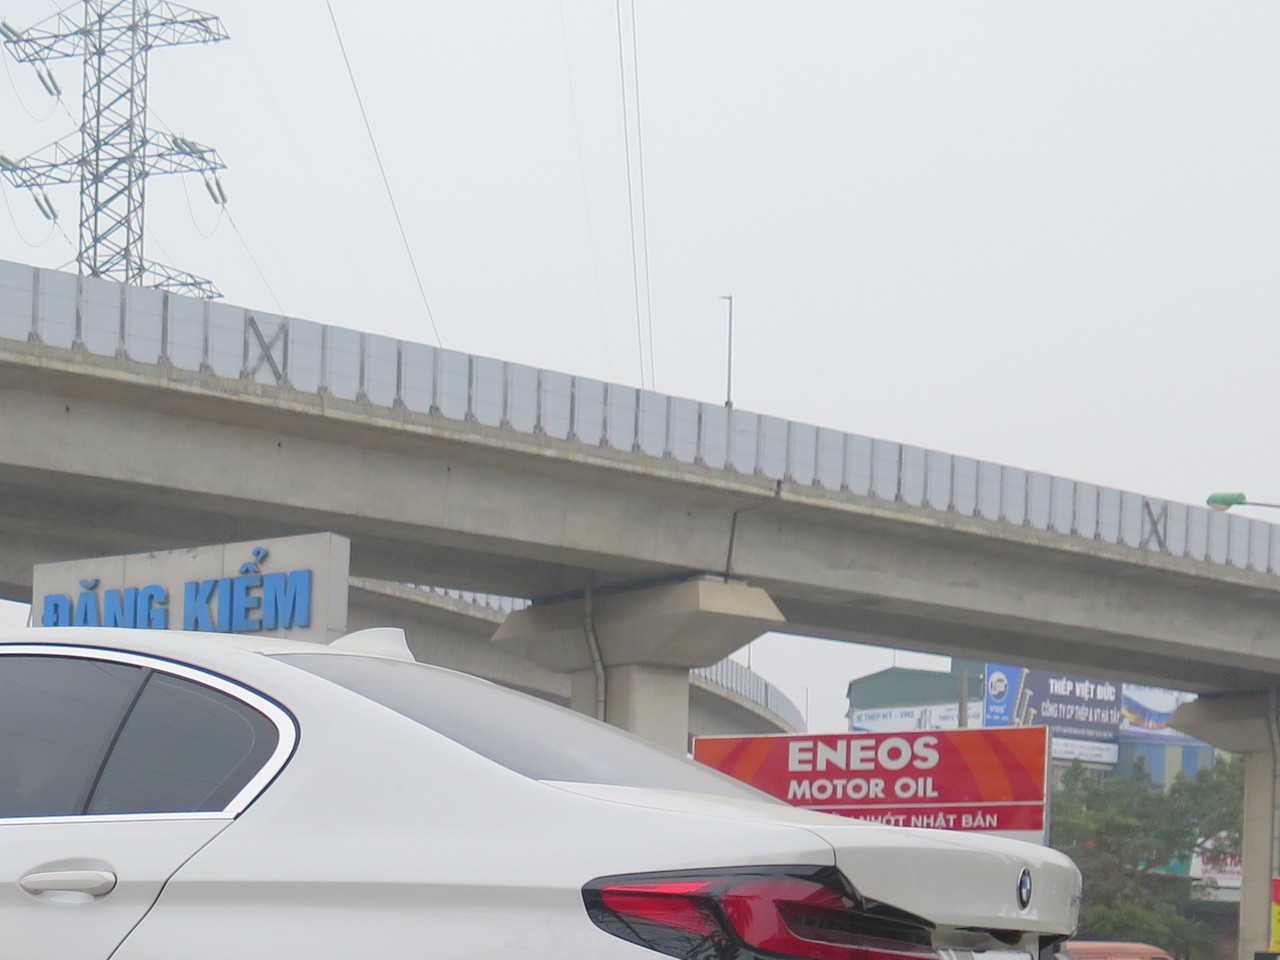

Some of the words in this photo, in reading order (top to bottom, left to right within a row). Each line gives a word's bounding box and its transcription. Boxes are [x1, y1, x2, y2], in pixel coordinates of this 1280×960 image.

[42, 578, 168, 629] ĐĂNG
[183, 546, 313, 633] KIỂM
[788, 735, 940, 772] ENEOS
[787, 777, 885, 800] MOTOR
[894, 776, 939, 799] OIL
[910, 812, 957, 829] NHẬT
[961, 811, 998, 828] BẢN
